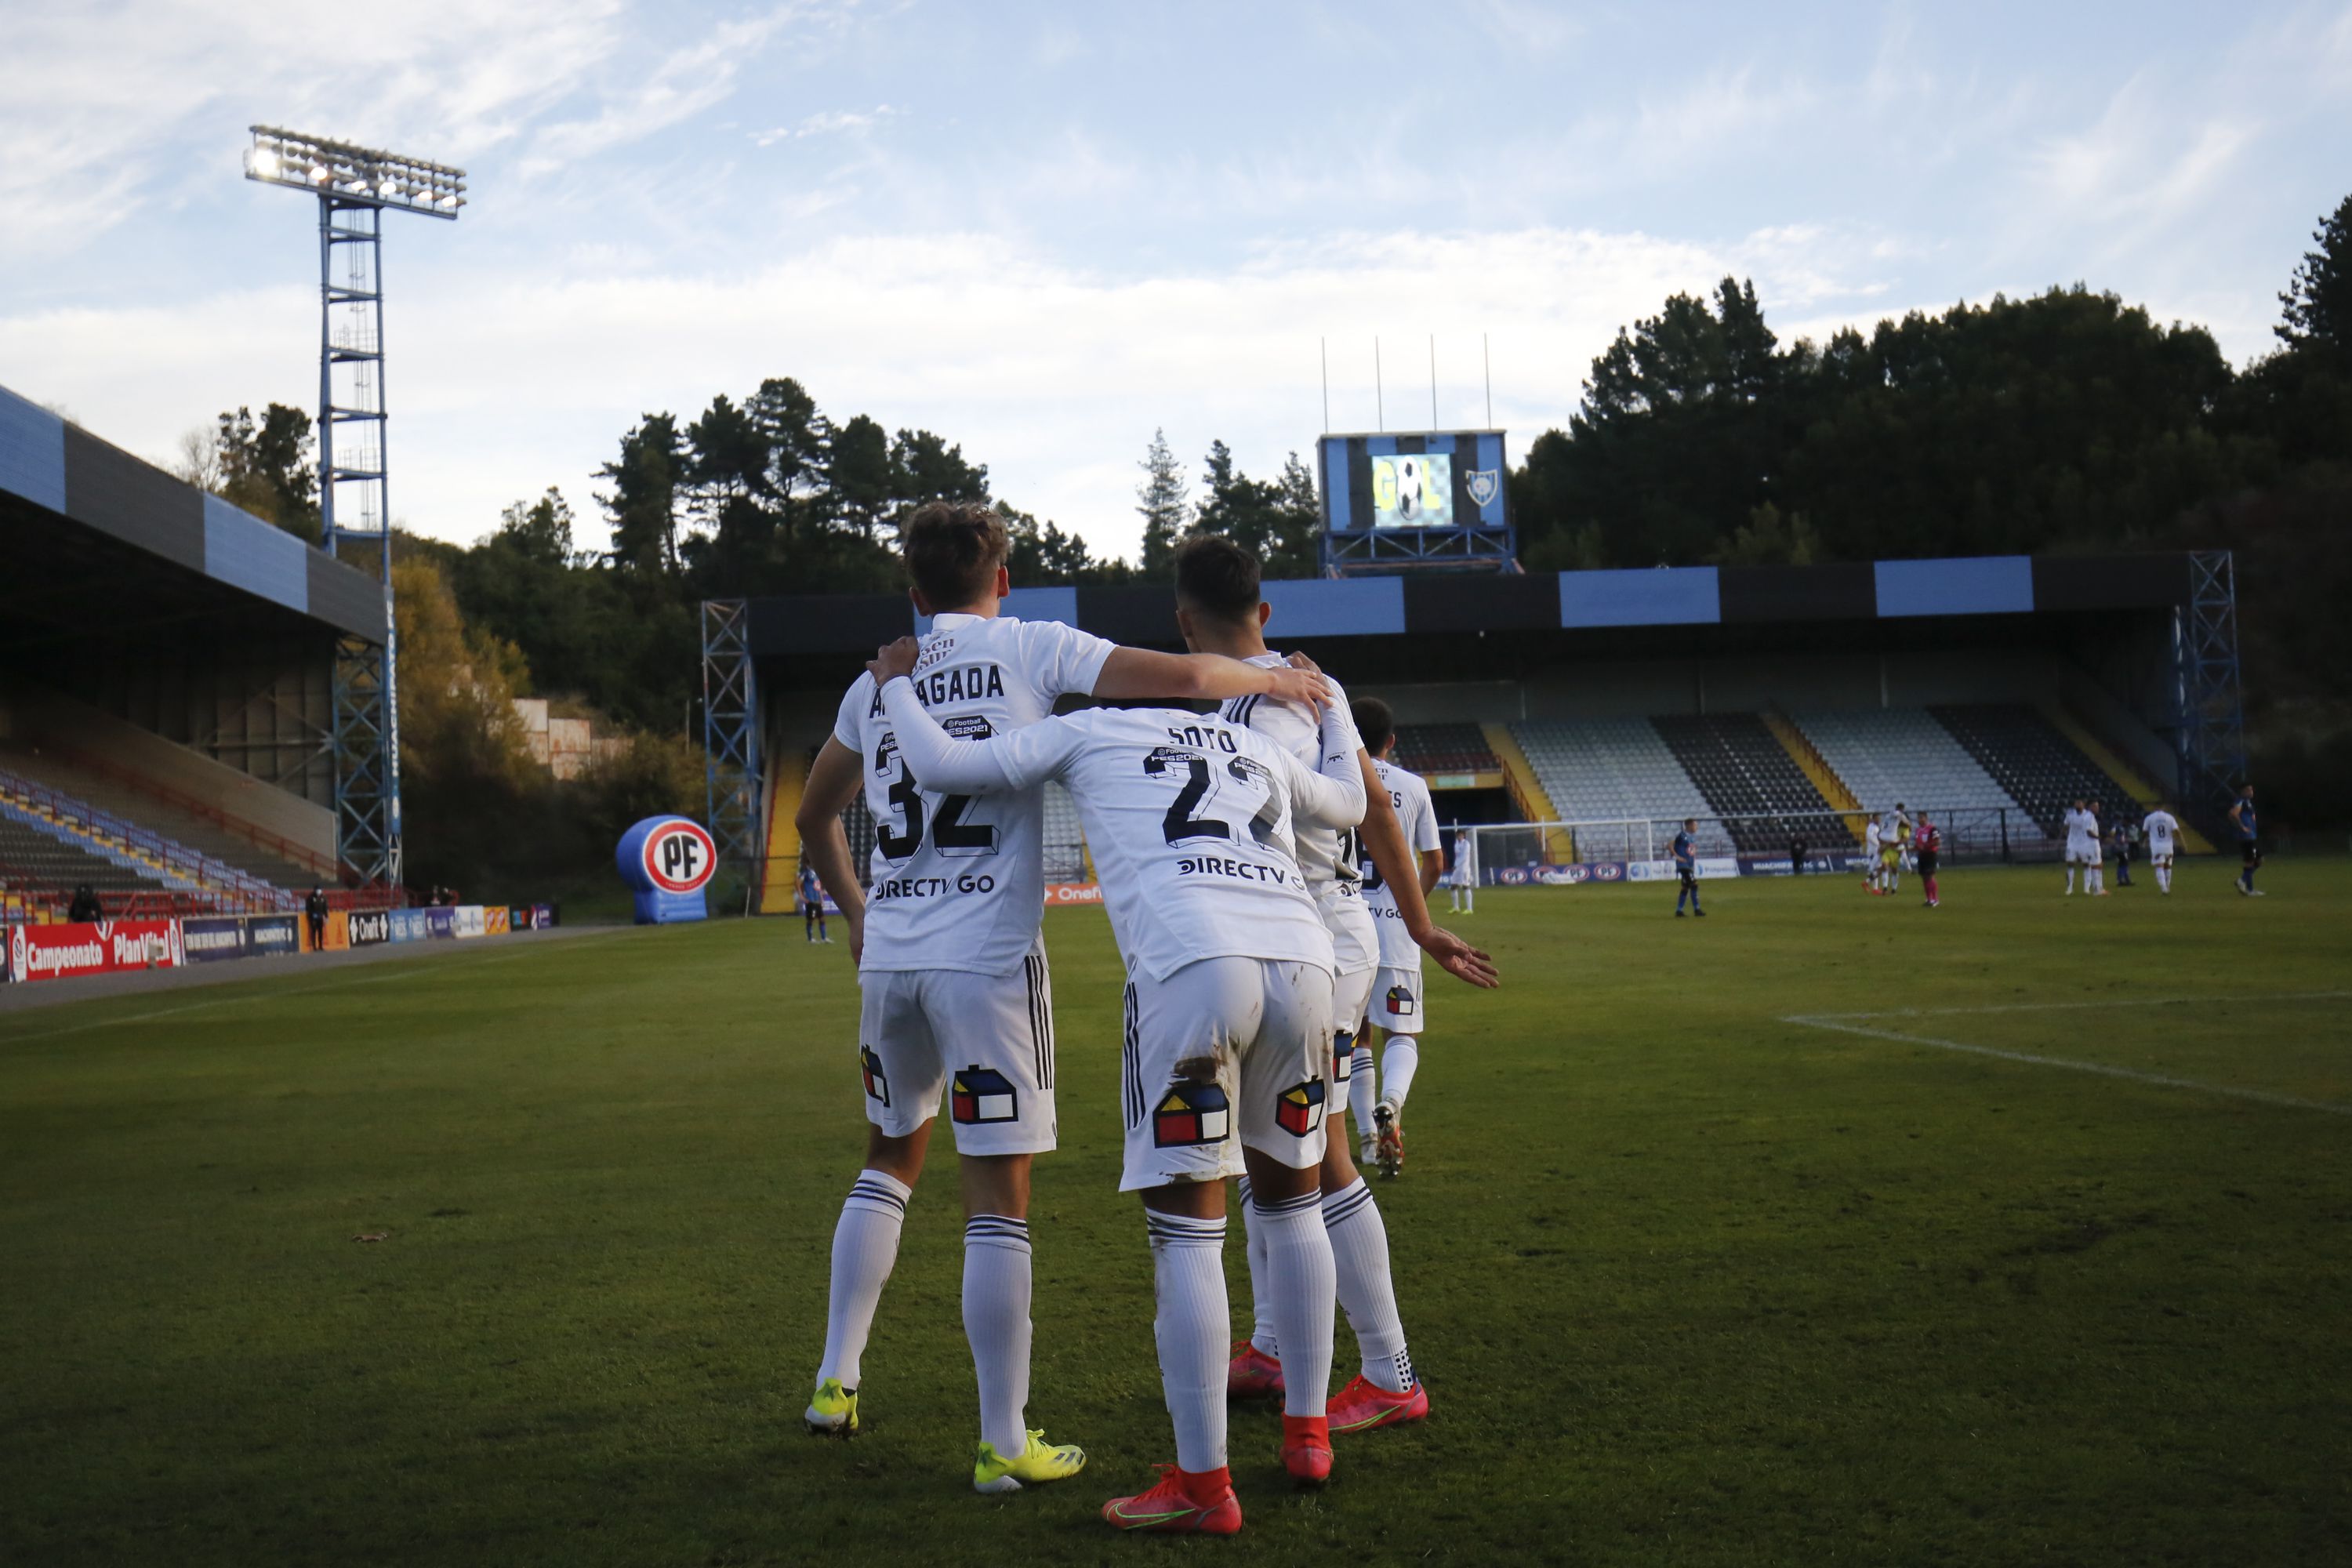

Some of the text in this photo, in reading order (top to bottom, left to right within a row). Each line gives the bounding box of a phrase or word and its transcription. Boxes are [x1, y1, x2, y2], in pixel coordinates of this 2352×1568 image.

[1167, 726, 1237, 753] SOTO
[662, 834, 698, 879] PF
[957, 875, 995, 893] GO
[1177, 857, 1285, 884] DIRECTV
[27, 939, 103, 977] Campeonato
